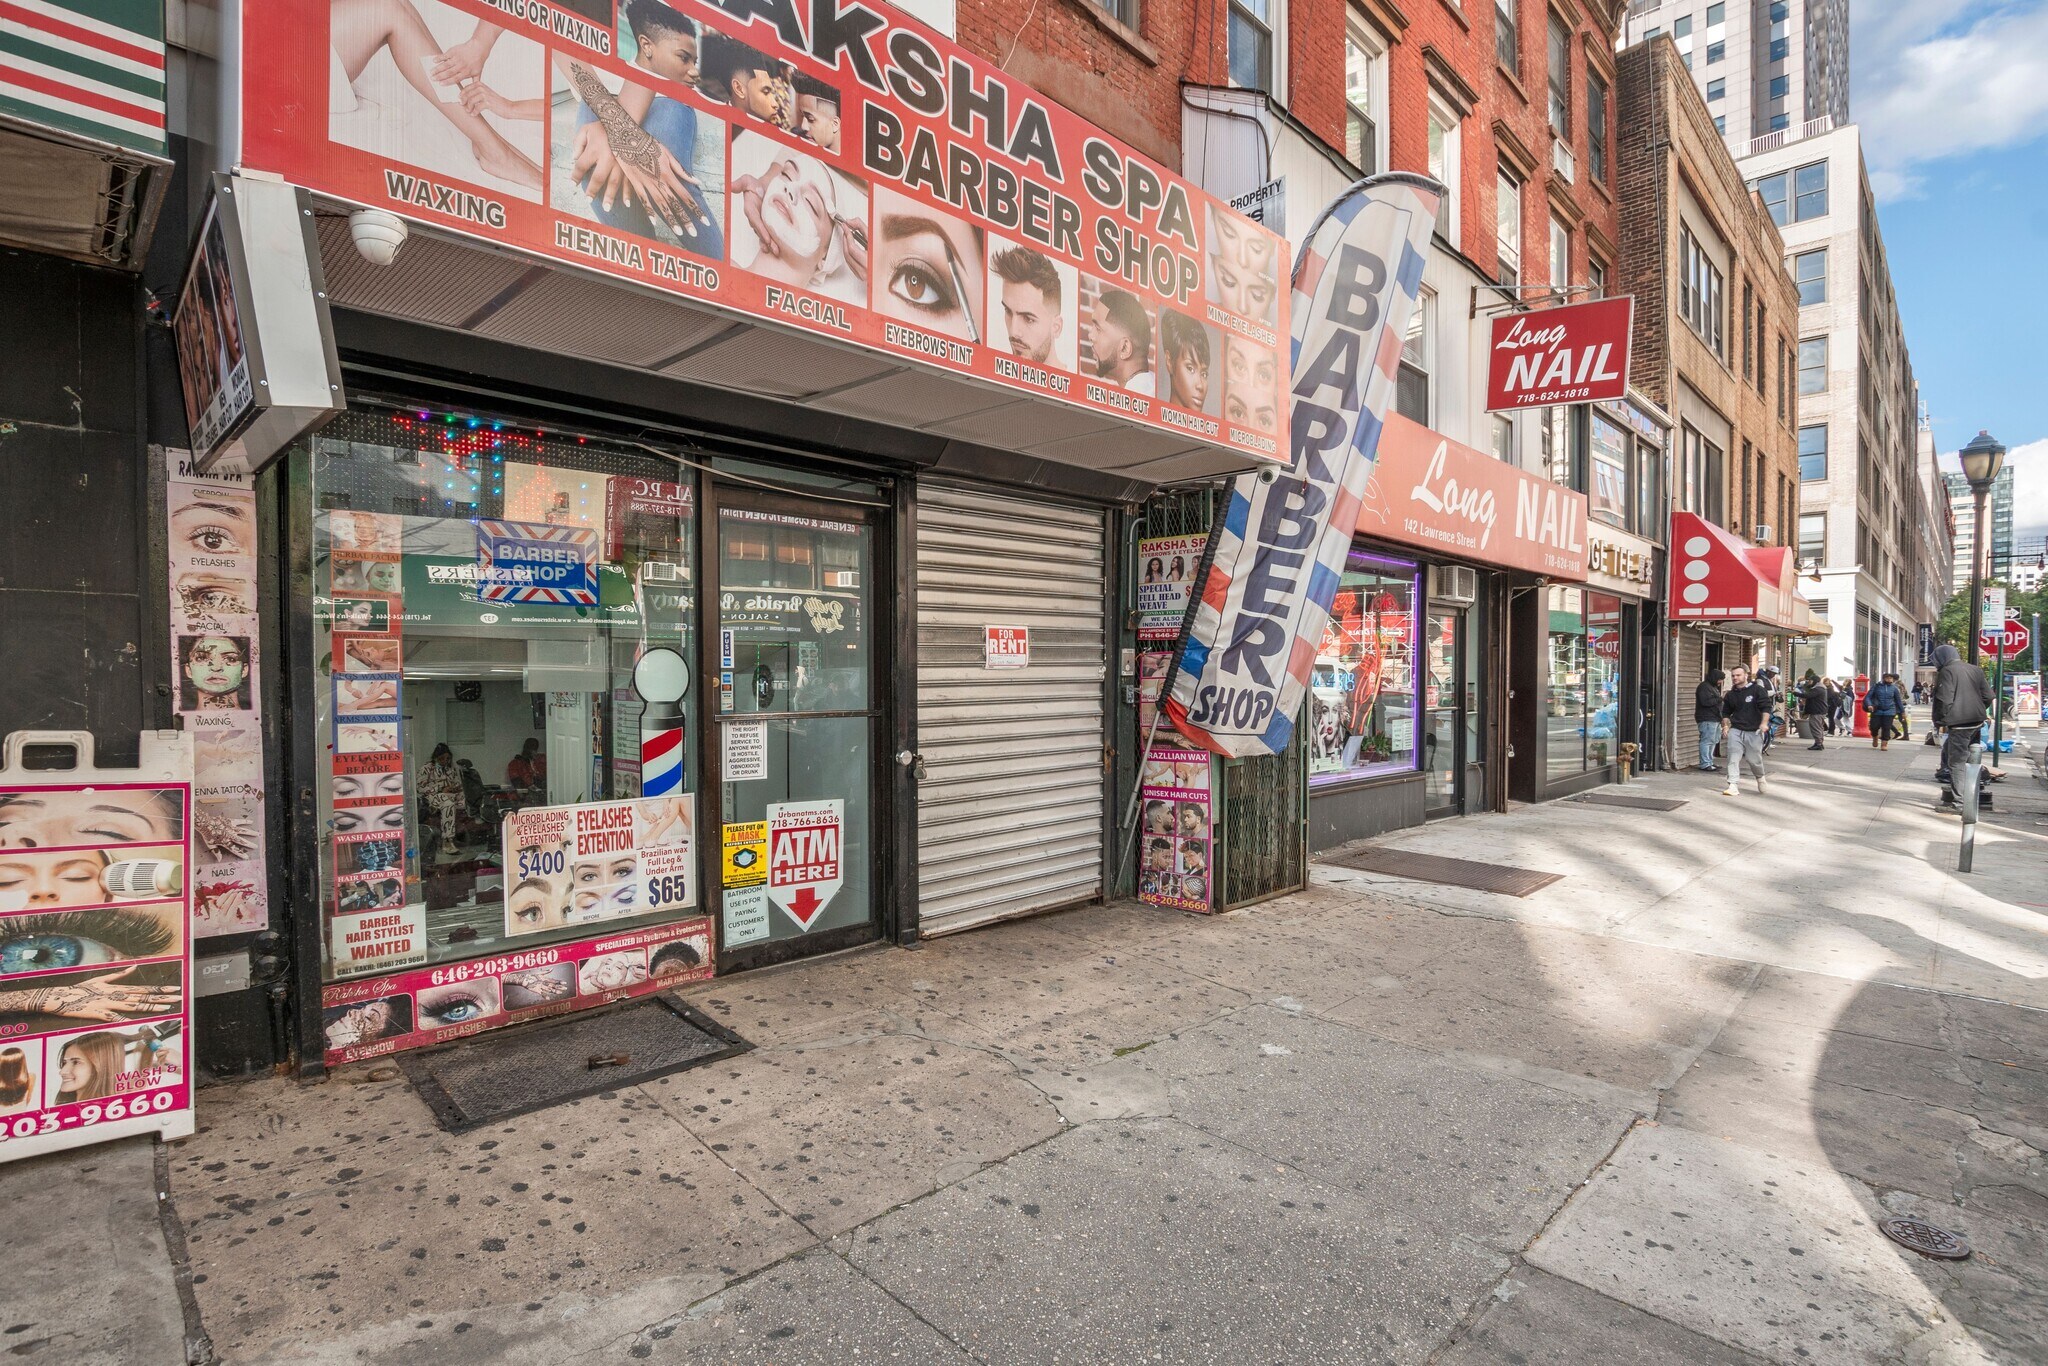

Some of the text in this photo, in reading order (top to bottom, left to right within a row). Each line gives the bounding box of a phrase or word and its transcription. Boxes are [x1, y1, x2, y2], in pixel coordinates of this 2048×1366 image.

[528, 2, 611, 56] OR WAXING
[717, 0, 1200, 253] AKSHA SPA
[384, 169, 506, 229] WAXING
[863, 98, 1201, 308] BARBER SHOP
[1230, 179, 1282, 211] PROPERTY
[554, 220, 720, 292] HENNA TATTO
[765, 285, 852, 333] FACIAL
[1207, 305, 1277, 347] MINK EYELASHES
[1495, 317, 1567, 354] Long
[884, 321, 973, 368] EYEBROWS TINT
[994, 357, 1071, 395] MEN HAIR CUT
[1503, 342, 1619, 393] NAIL
[1086, 384, 1150, 416] MEN HAIR CUT
[1516, 387, 1590, 404] 718-624-1818
[1161, 407, 1219, 438] WOMAN HAIR CUT
[1229, 428, 1277, 454] MICROBLADING
[1220, 243, 1388, 690] BARBER
[1411, 440, 1582, 554] Long NAIL
[1404, 517, 1476, 549] 142 Lawrence Street
[1141, 537, 1207, 553] RAKSHA SP
[191, 557, 236, 568] EYELASHES
[498, 543, 581, 566] BARBER
[1544, 553, 1580, 573] 718-624-1818
[1588, 537, 1608, 572] GE
[1613, 543, 1634, 580] TEE
[513, 559, 568, 582] SHOP
[1139, 583, 1174, 593] SPECIAL
[1139, 592, 1182, 601] FULL HEAD
[1139, 601, 1168, 611] WEAVE
[196, 621, 226, 631] FACIAL
[999, 629, 1014, 639] FOR
[723, 632, 731, 656] PUSH
[989, 638, 1026, 654] RENT
[361, 673, 402, 681] WAXING
[1193, 685, 1279, 731] SHOP
[195, 716, 232, 727] WAXING
[333, 716, 360, 724] ARMS
[335, 753, 401, 764] EYELASHES
[1187, 753, 1208, 761] WAX
[346, 765, 391, 775] BEFORE
[195, 786, 219, 797] ENNA
[1144, 789, 1208, 801] UNISEX HAIR CUTS
[351, 797, 388, 808] AFTER
[512, 811, 569, 826] MICROBLADING
[577, 806, 633, 832] EYELASHES
[771, 815, 840, 829] 718-766-8636
[778, 808, 834, 819] Urbanatms.com
[337, 830, 403, 843] WASH AND SET
[516, 821, 565, 836] & EYELASHES
[731, 831, 760, 842] A MASK
[520, 833, 562, 847] EXTENTION
[577, 829, 634, 856] EXTENTION
[772, 828, 837, 868] ATM
[641, 848, 673, 859] Brazilian
[647, 855, 682, 866] Full Leg &
[211, 868, 235, 878] NAILS
[519, 850, 565, 881] $400
[645, 864, 684, 876] Under Arm
[774, 863, 836, 885] HERE
[337, 869, 404, 883] HAIR BLOW DRY
[648, 875, 686, 907] $65
[727, 886, 763, 899] BATHROOM
[747, 896, 761, 905] FOR
[1140, 892, 1208, 912] 646-203-9660
[735, 908, 757, 918] PAYING
[359, 914, 401, 931] BARBER
[728, 915, 764, 929] CUSTOMERS
[346, 924, 415, 944] HAIR STYLIST
[595, 923, 706, 953] SPECIALIZED Eyebrow Eyelashes
[740, 928, 756, 937] ONLY
[351, 938, 411, 961] WANTED
[337, 966, 352, 976] CALL
[431, 949, 559, 986] 646-203-9660
[673, 970, 707, 985] HAIR CUT
[323, 978, 398, 1002] Raksha Spa
[602, 988, 630, 1002] FACIAL
[539, 1001, 571, 1018] TATTOO
[436, 1020, 487, 1040] EYELASHES
[345, 1040, 396, 1060] EYEBROW
[115, 1063, 178, 1083] WASH &
[115, 1076, 162, 1093] BLOW
